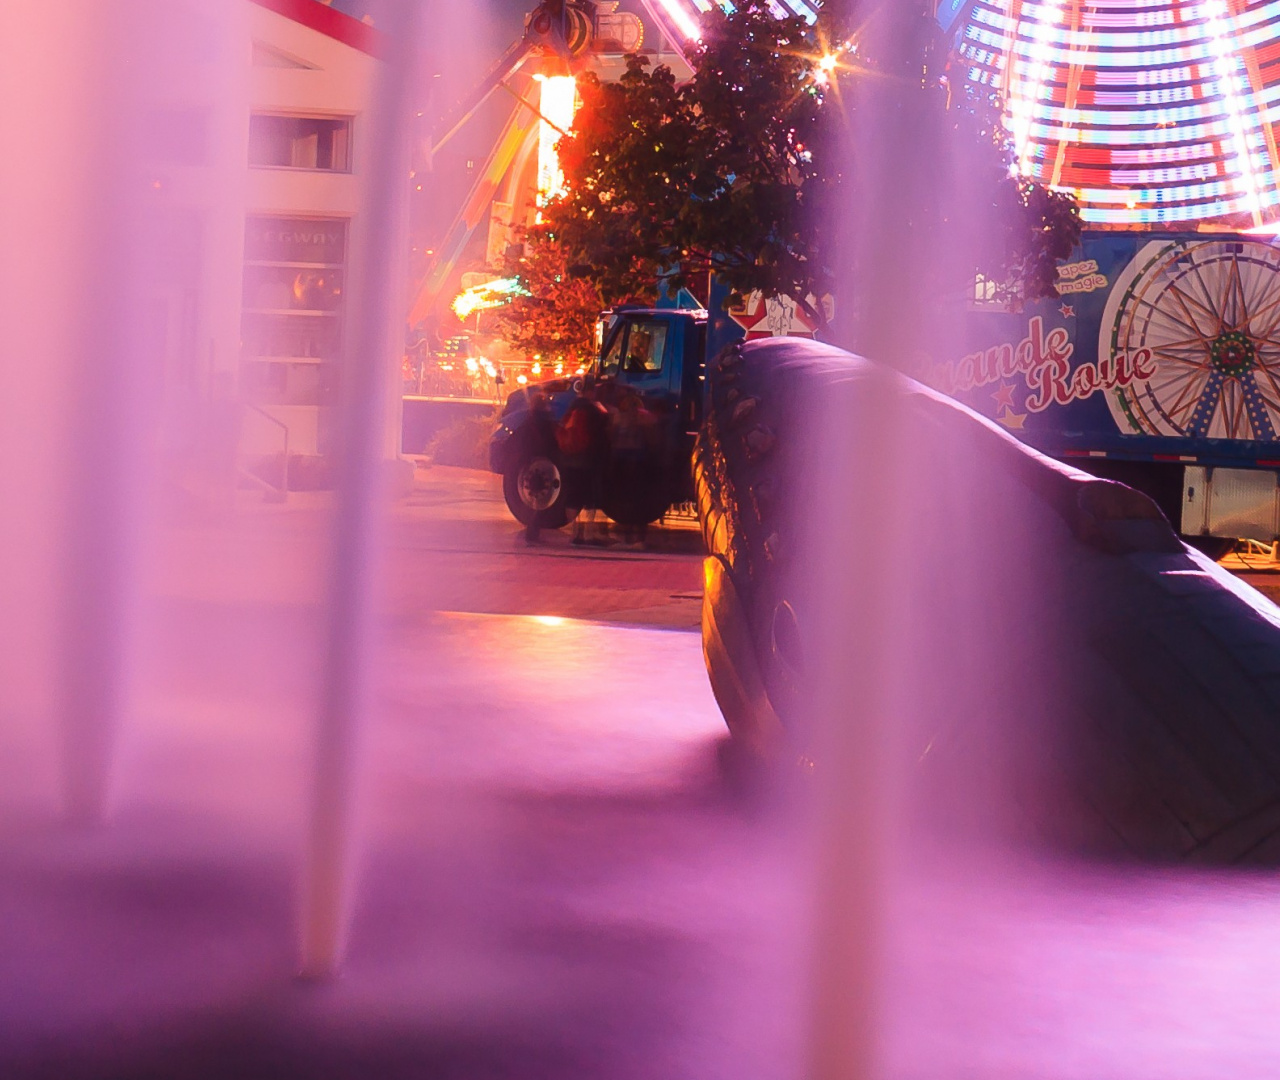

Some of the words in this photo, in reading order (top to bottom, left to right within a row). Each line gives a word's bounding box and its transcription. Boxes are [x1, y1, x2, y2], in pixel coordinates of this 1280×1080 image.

[1060, 262, 1096, 276] apez
[1061, 275, 1105, 290] magie
[1026, 347, 1158, 413] Roue
